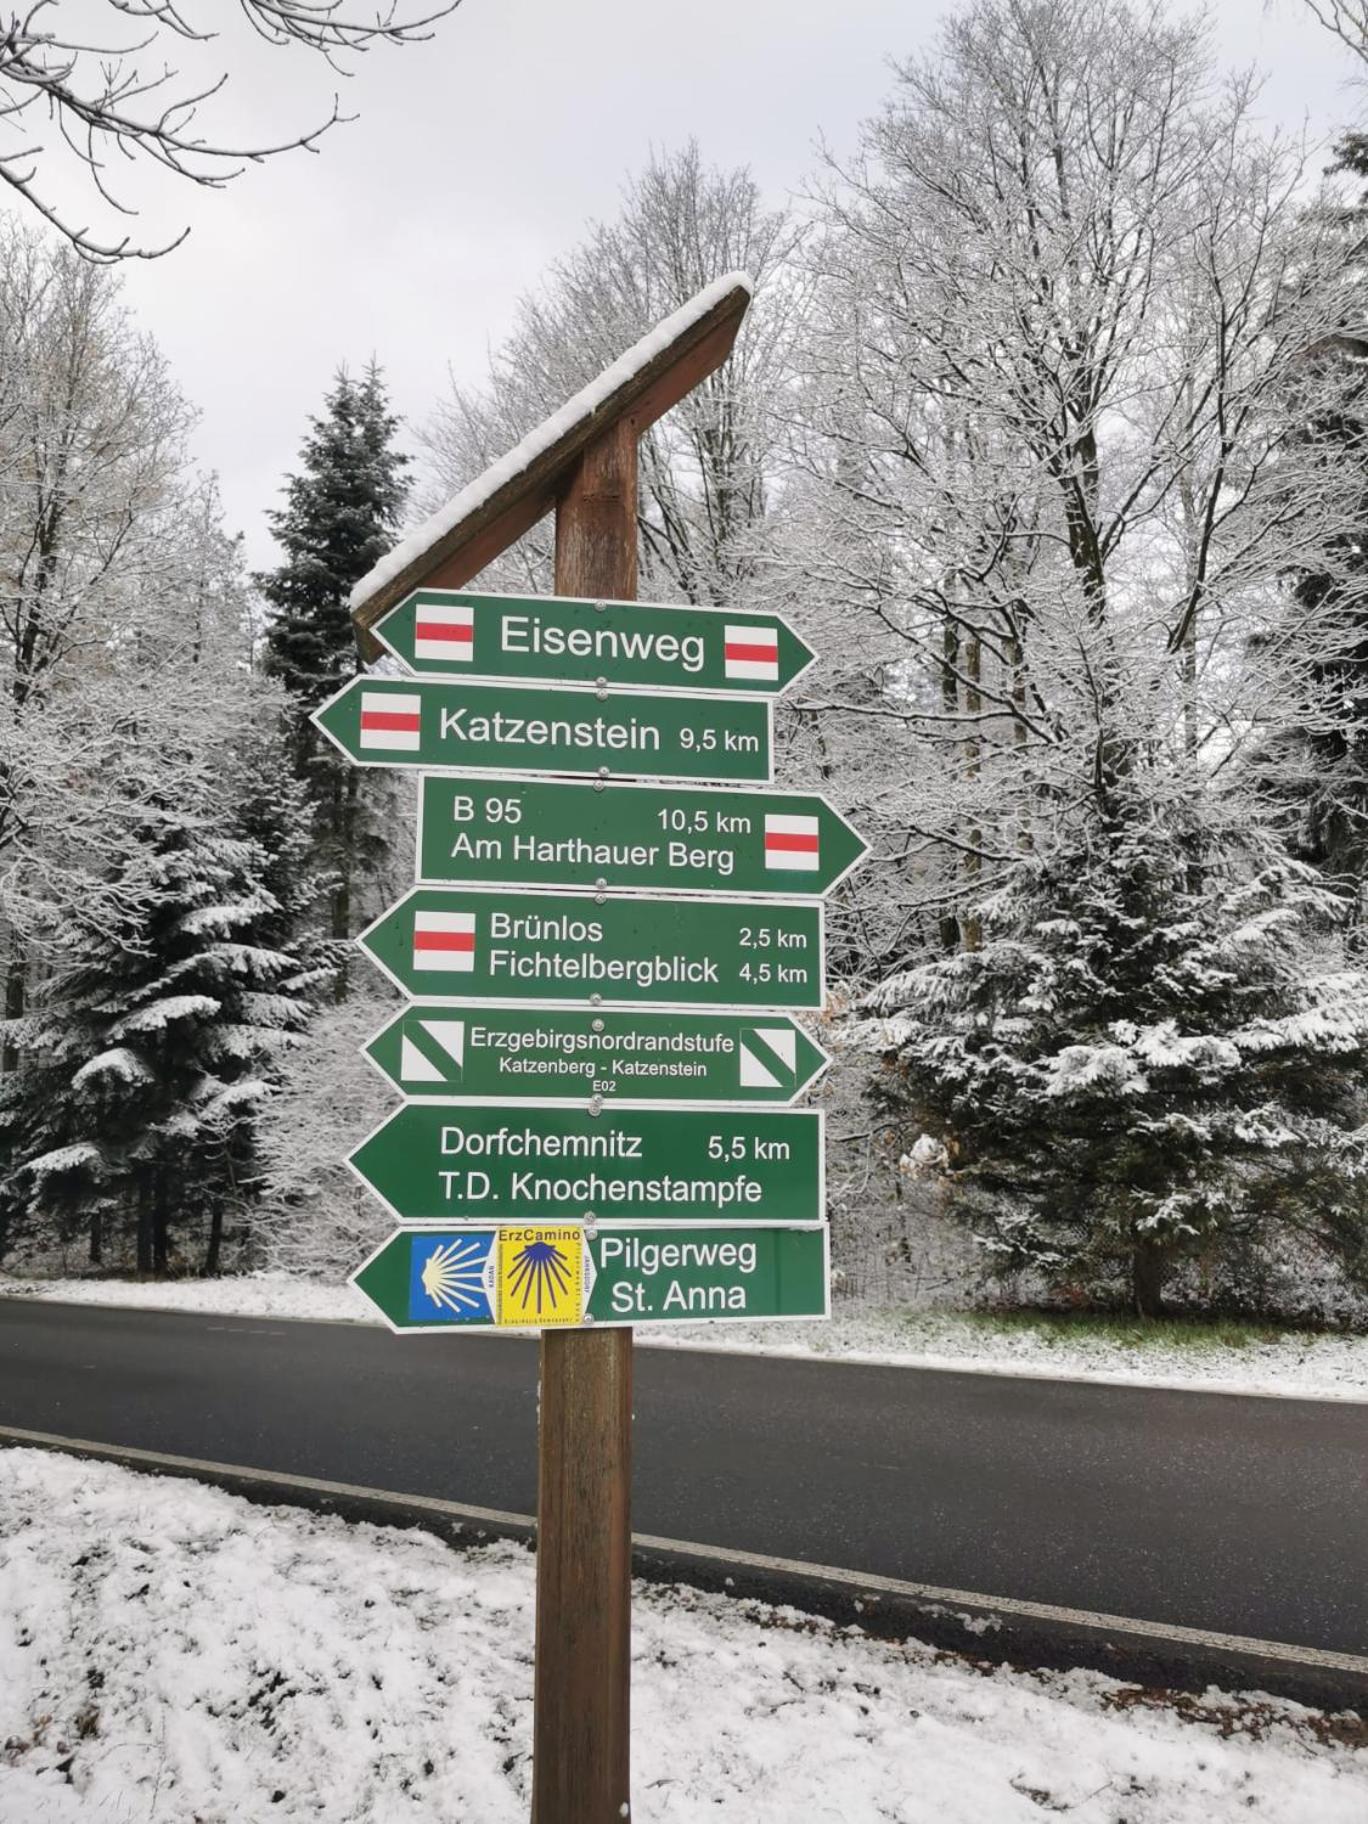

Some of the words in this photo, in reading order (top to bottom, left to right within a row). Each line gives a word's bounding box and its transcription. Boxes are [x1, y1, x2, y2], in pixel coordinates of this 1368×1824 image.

[502, 616, 704, 672] Eisenweg
[441, 708, 659, 750] Katzenstein
[680, 728, 716, 752] 9,5
[725, 730, 758, 751] km
[454, 796, 474, 821] B
[486, 798, 521, 823] 95
[658, 809, 708, 834] 10,5
[717, 812, 750, 833] km
[451, 833, 501, 859] Am
[514, 835, 659, 865] Harthauer
[669, 842, 733, 875] Berg
[491, 913, 603, 941] Brünlos
[740, 928, 770, 949] 2,5
[778, 929, 806, 948] km
[490, 950, 718, 987] Fichtelbergblick
[739, 963, 771, 984] 4,5
[778, 964, 807, 983] km
[471, 1027, 734, 1053] Erzgebirgsnordrandstufe
[500, 1057, 595, 1078] Katzenberg
[613, 1060, 706, 1076] Katzenstein
[593, 1080, 616, 1091] E02
[441, 1127, 642, 1157] Dorfchemnitz
[709, 1136, 745, 1162] 5,5
[755, 1137, 789, 1159] km
[439, 1172, 498, 1199] T.D.
[512, 1173, 761, 1208] Knochenstampfe
[499, 1229, 581, 1241] ErzCamino
[601, 1238, 756, 1275] Pilgerweg
[612, 1281, 652, 1312] St.
[664, 1280, 746, 1310] Anna
